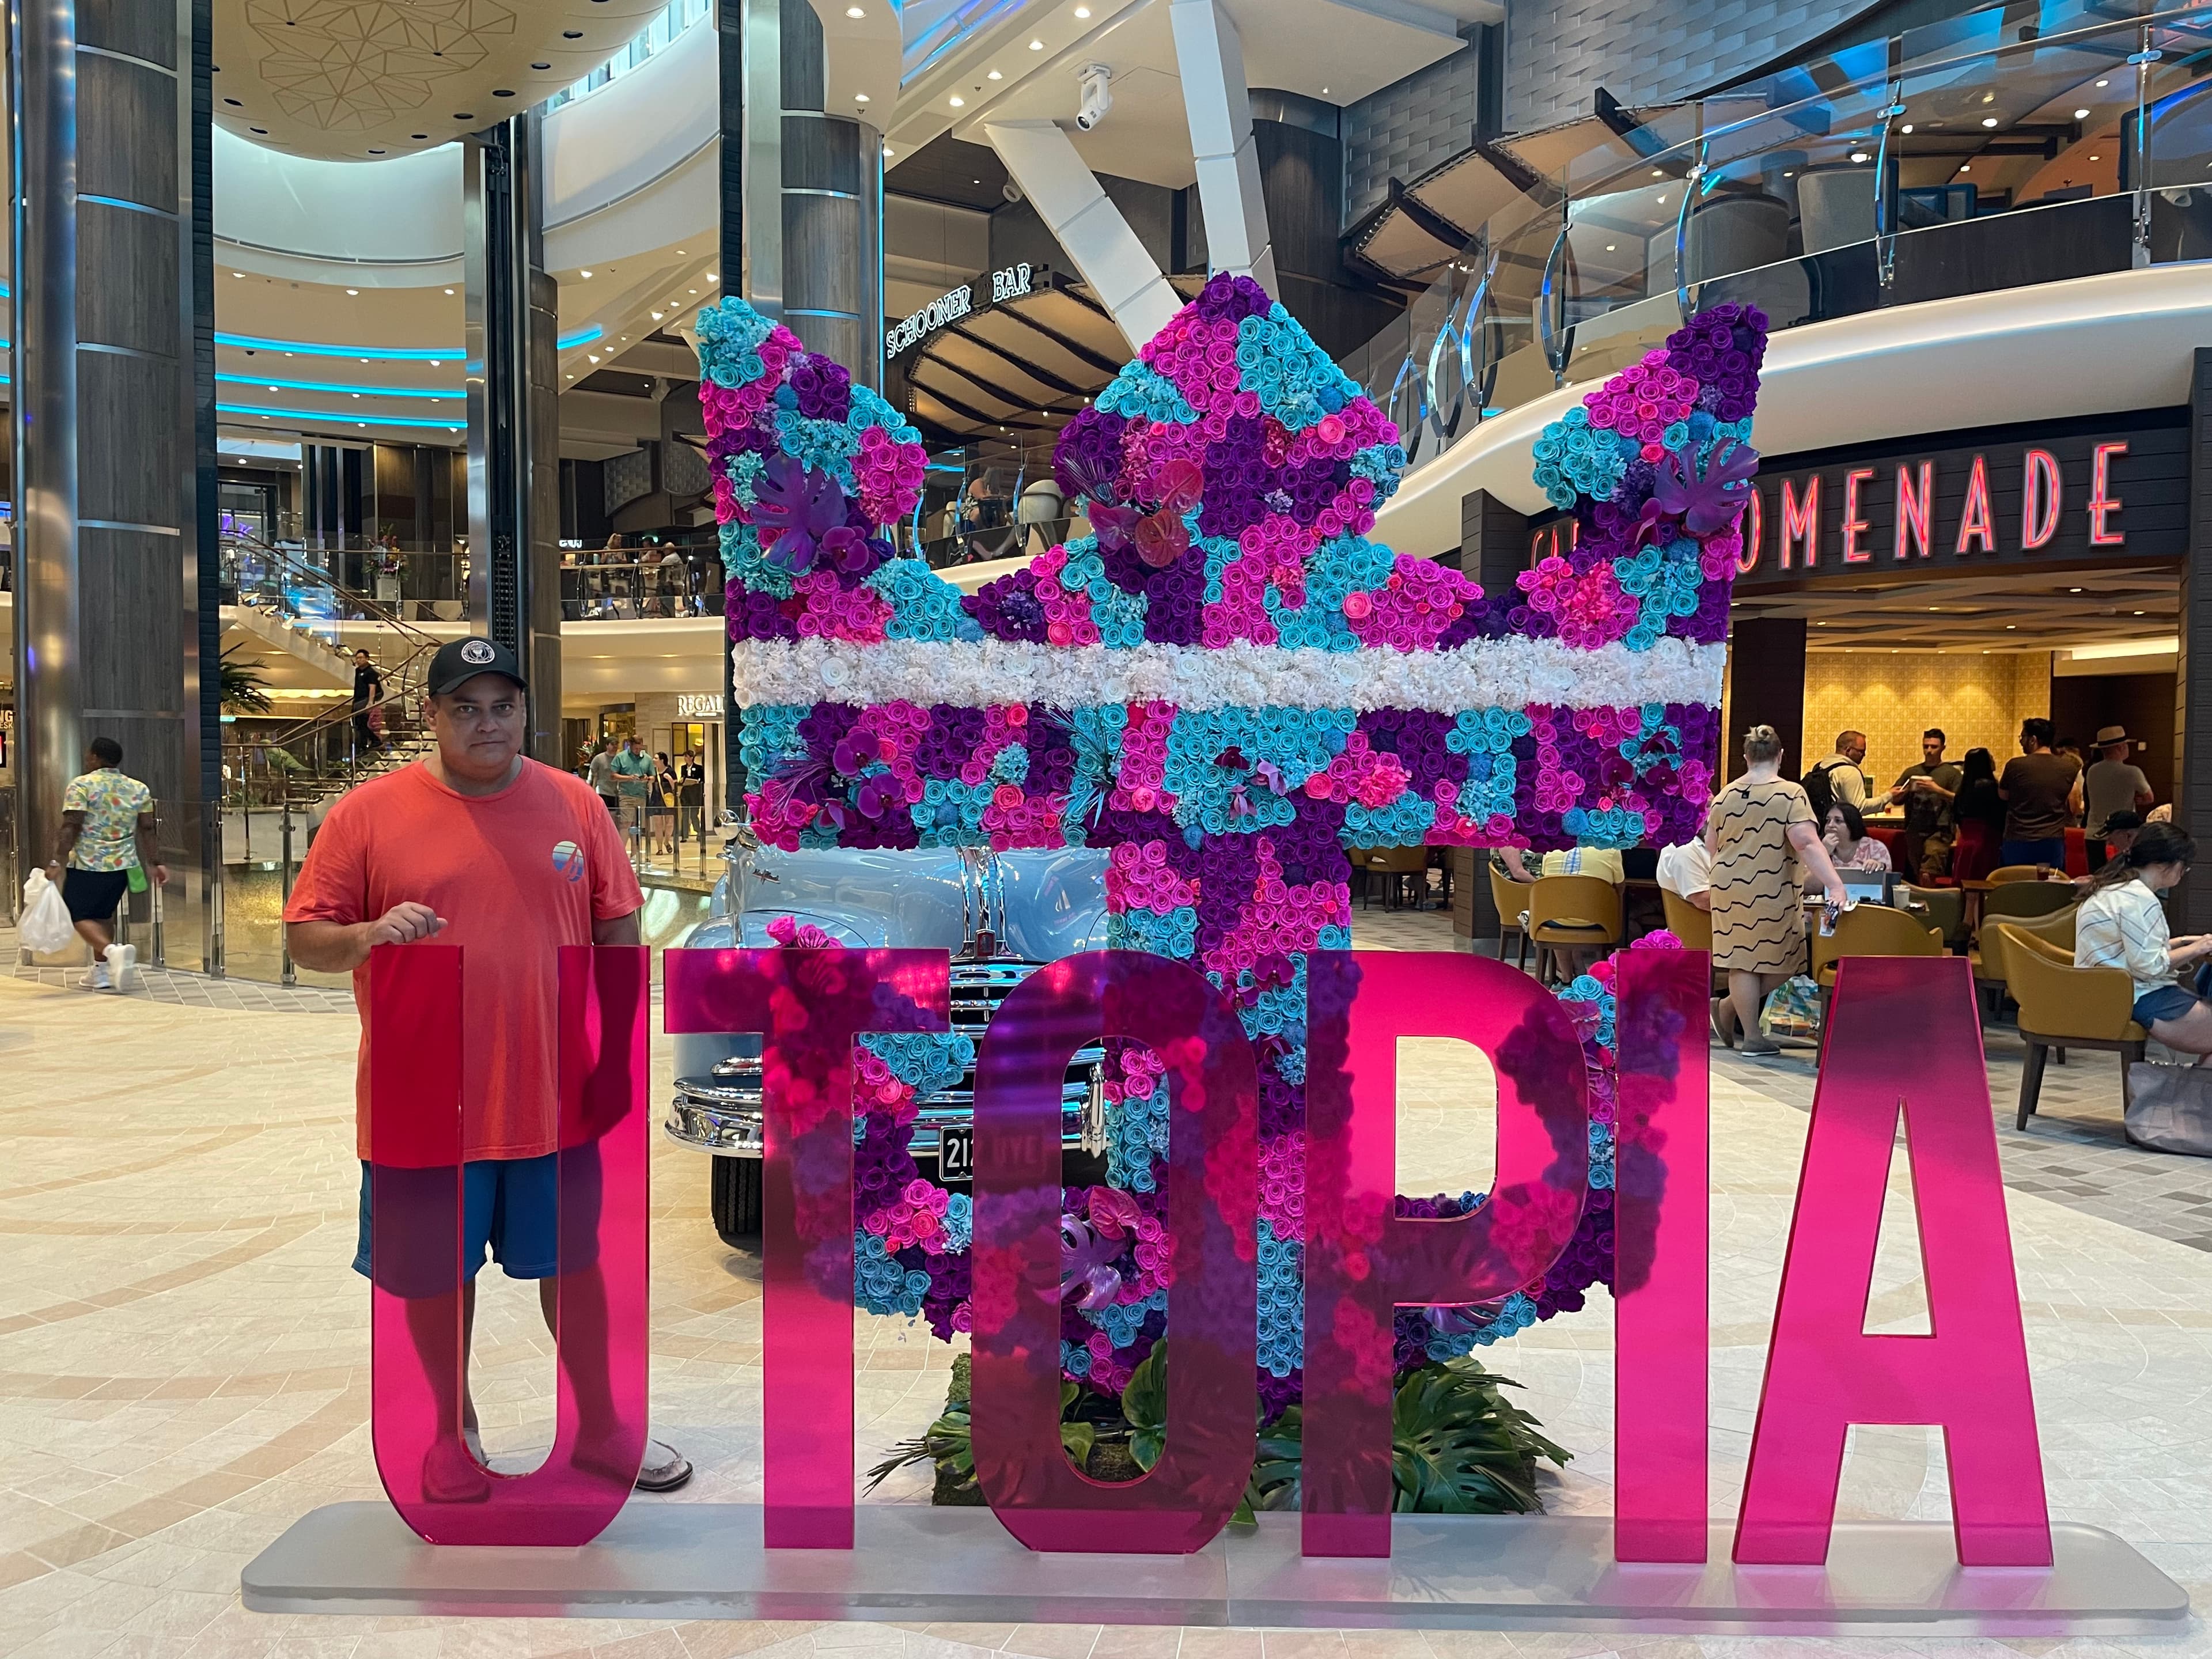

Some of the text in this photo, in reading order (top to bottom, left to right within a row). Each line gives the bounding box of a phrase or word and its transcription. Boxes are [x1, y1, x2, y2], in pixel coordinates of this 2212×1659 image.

[885, 262, 1032, 359] SCHOONER BAR
[1736, 441, 2128, 574] OMENADE
[946, 1138, 976, 1168] 21
[370, 944, 2054, 1567] UTOPIA
